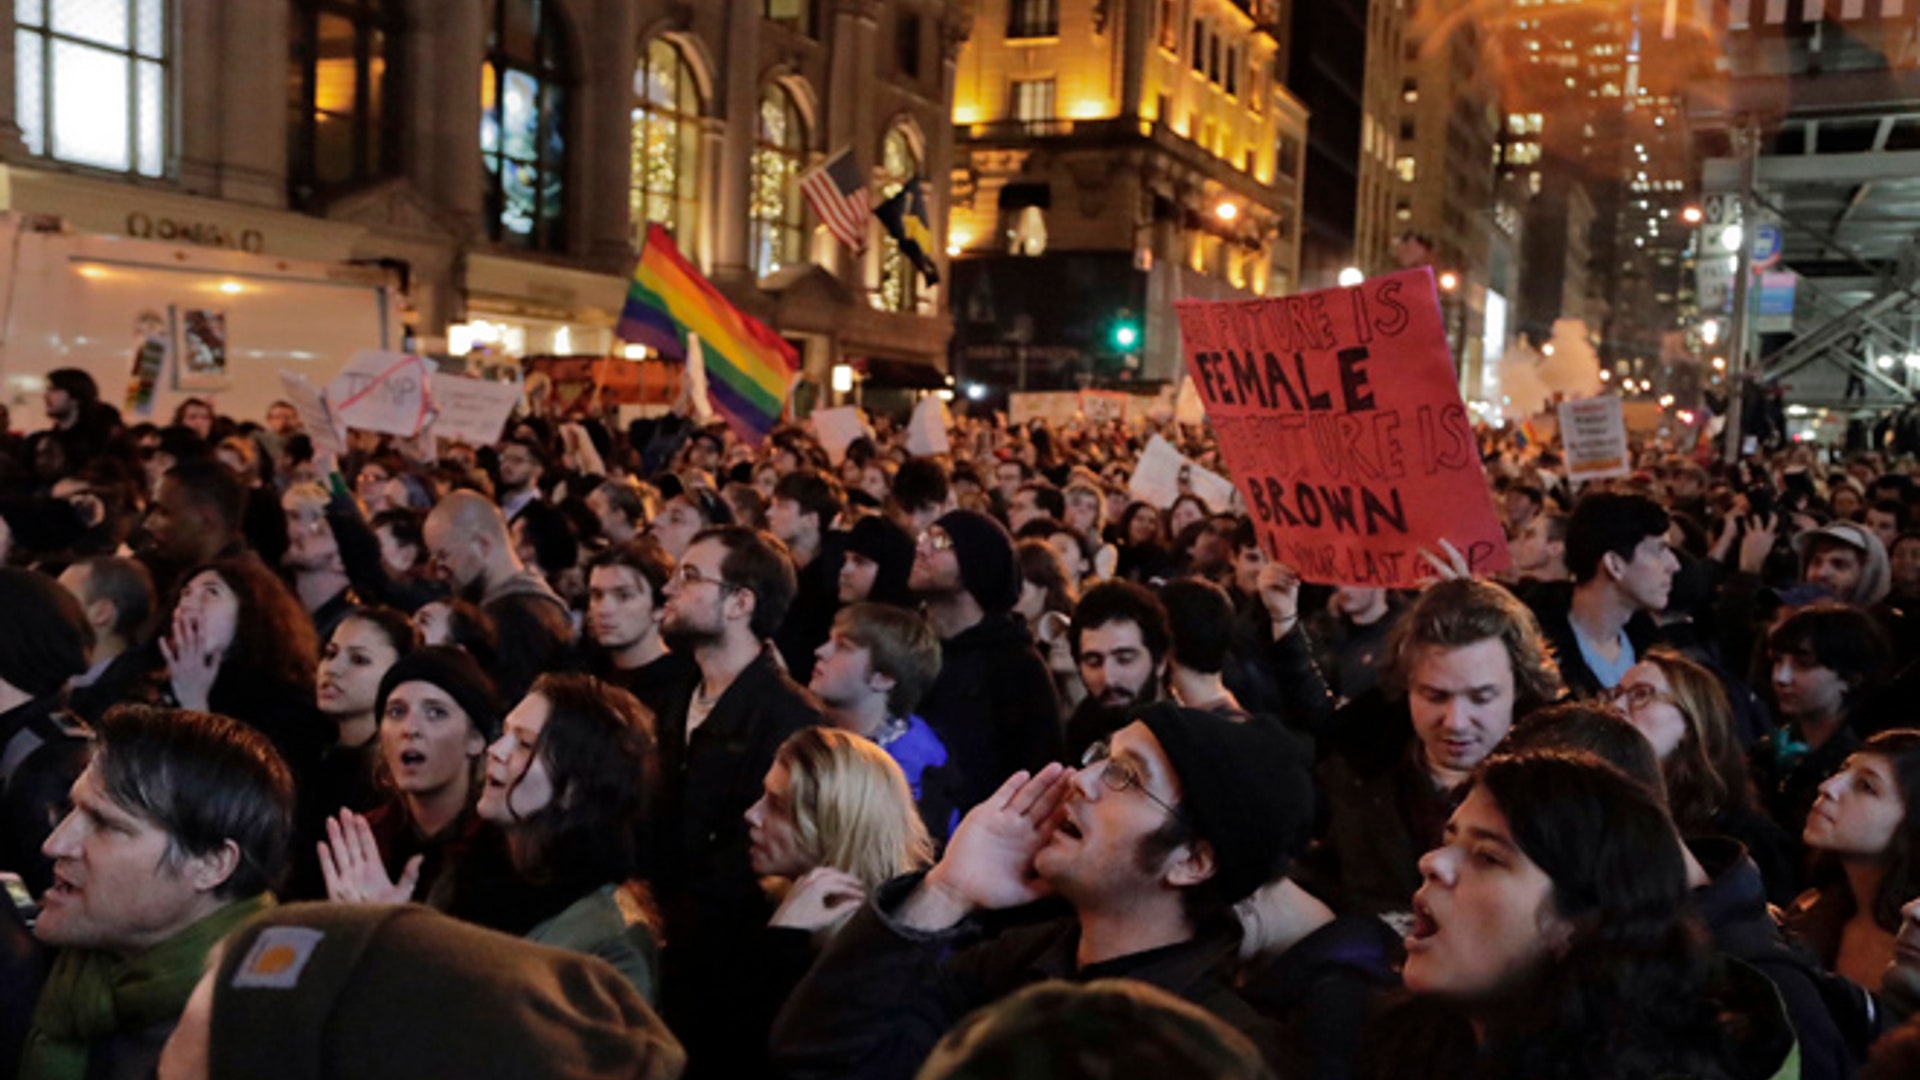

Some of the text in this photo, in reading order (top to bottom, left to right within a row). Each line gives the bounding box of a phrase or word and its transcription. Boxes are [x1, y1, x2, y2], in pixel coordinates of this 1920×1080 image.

[1351, 280, 1410, 345] IS
[1195, 346, 1376, 415] FEMALE
[1416, 404, 1471, 475] IS
[1247, 476, 1410, 535] BROWN
[1346, 546, 1405, 584] LAST
